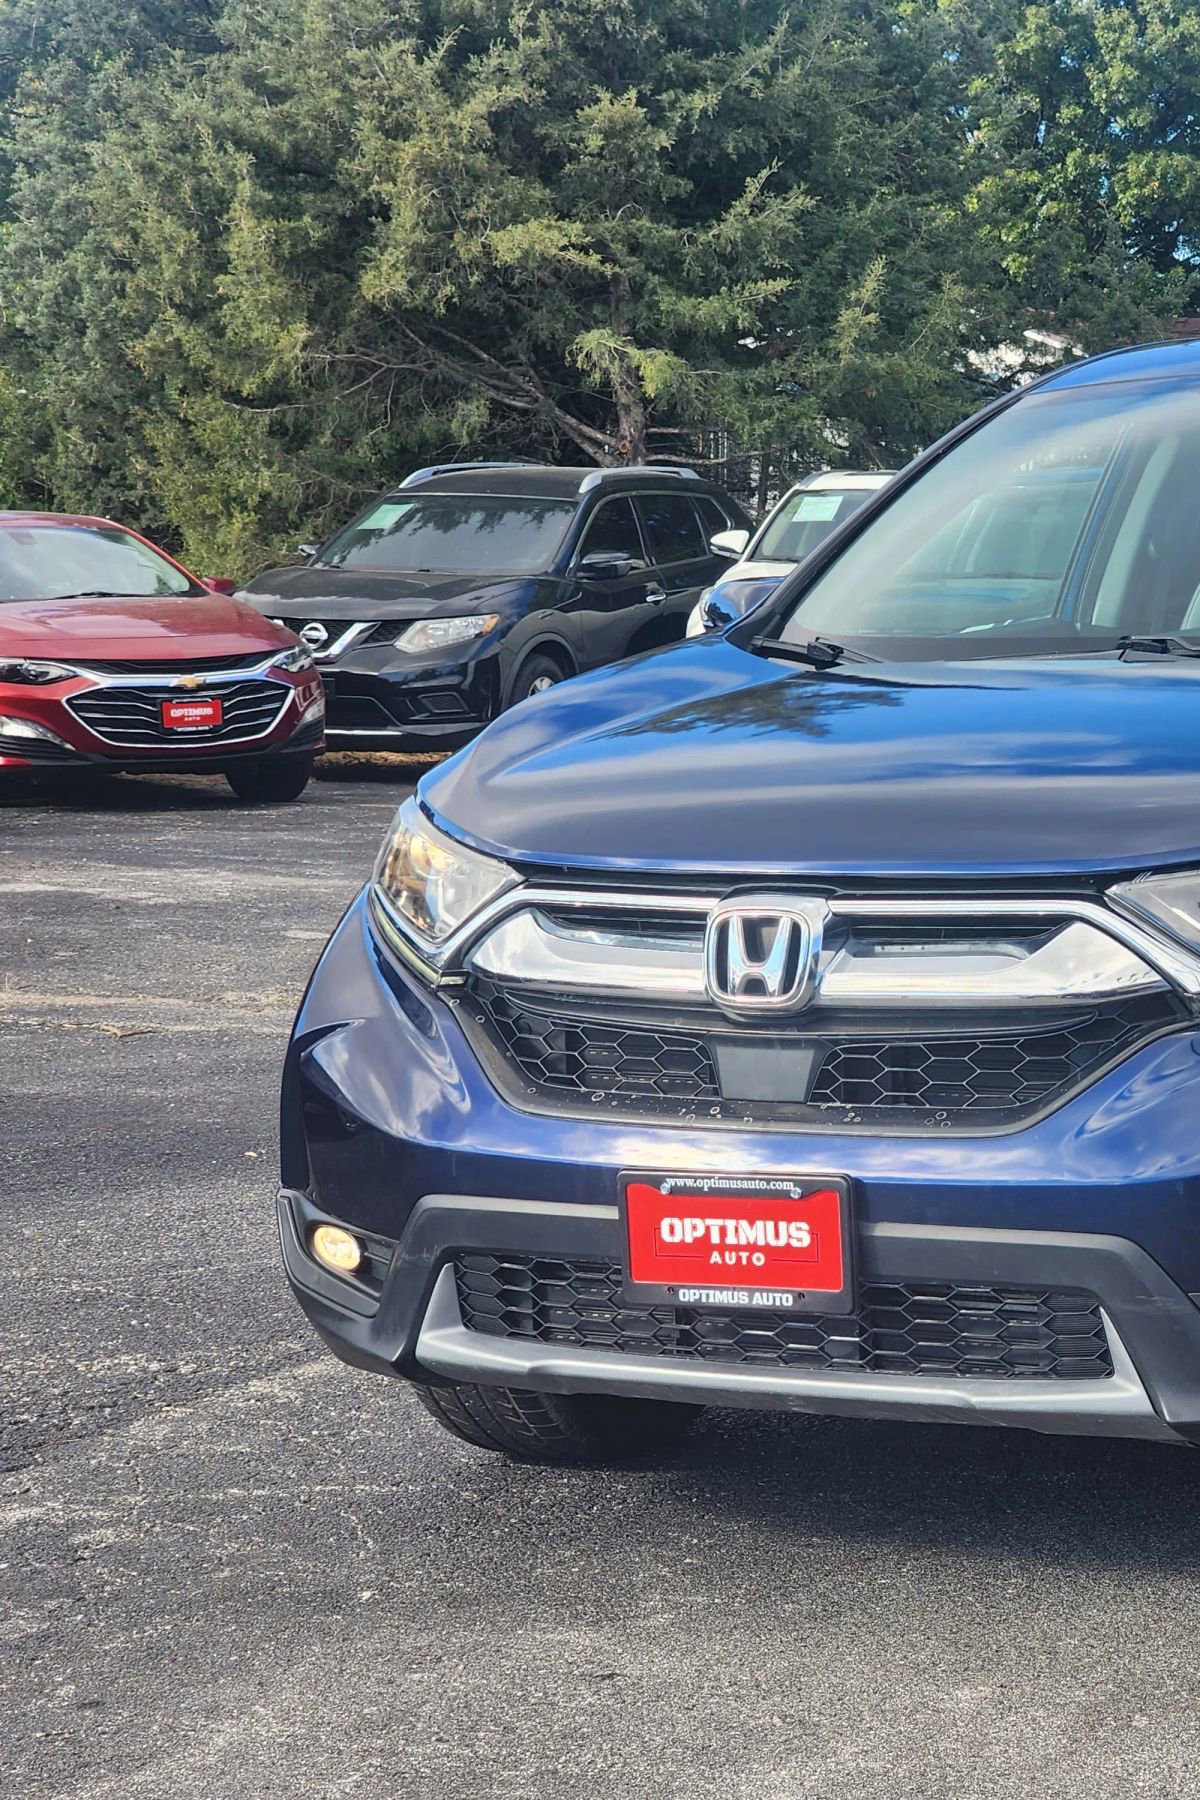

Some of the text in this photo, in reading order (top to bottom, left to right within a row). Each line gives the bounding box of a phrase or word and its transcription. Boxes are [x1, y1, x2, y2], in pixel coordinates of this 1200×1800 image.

[170, 707, 214, 717] OPTIMUS
[665, 1177, 795, 1191] www.optimusauto.com
[660, 1217, 811, 1248] OPTIMUS
[709, 1251, 766, 1266] AUTO
[678, 1289, 793, 1306] OPTIMUS AUTO
